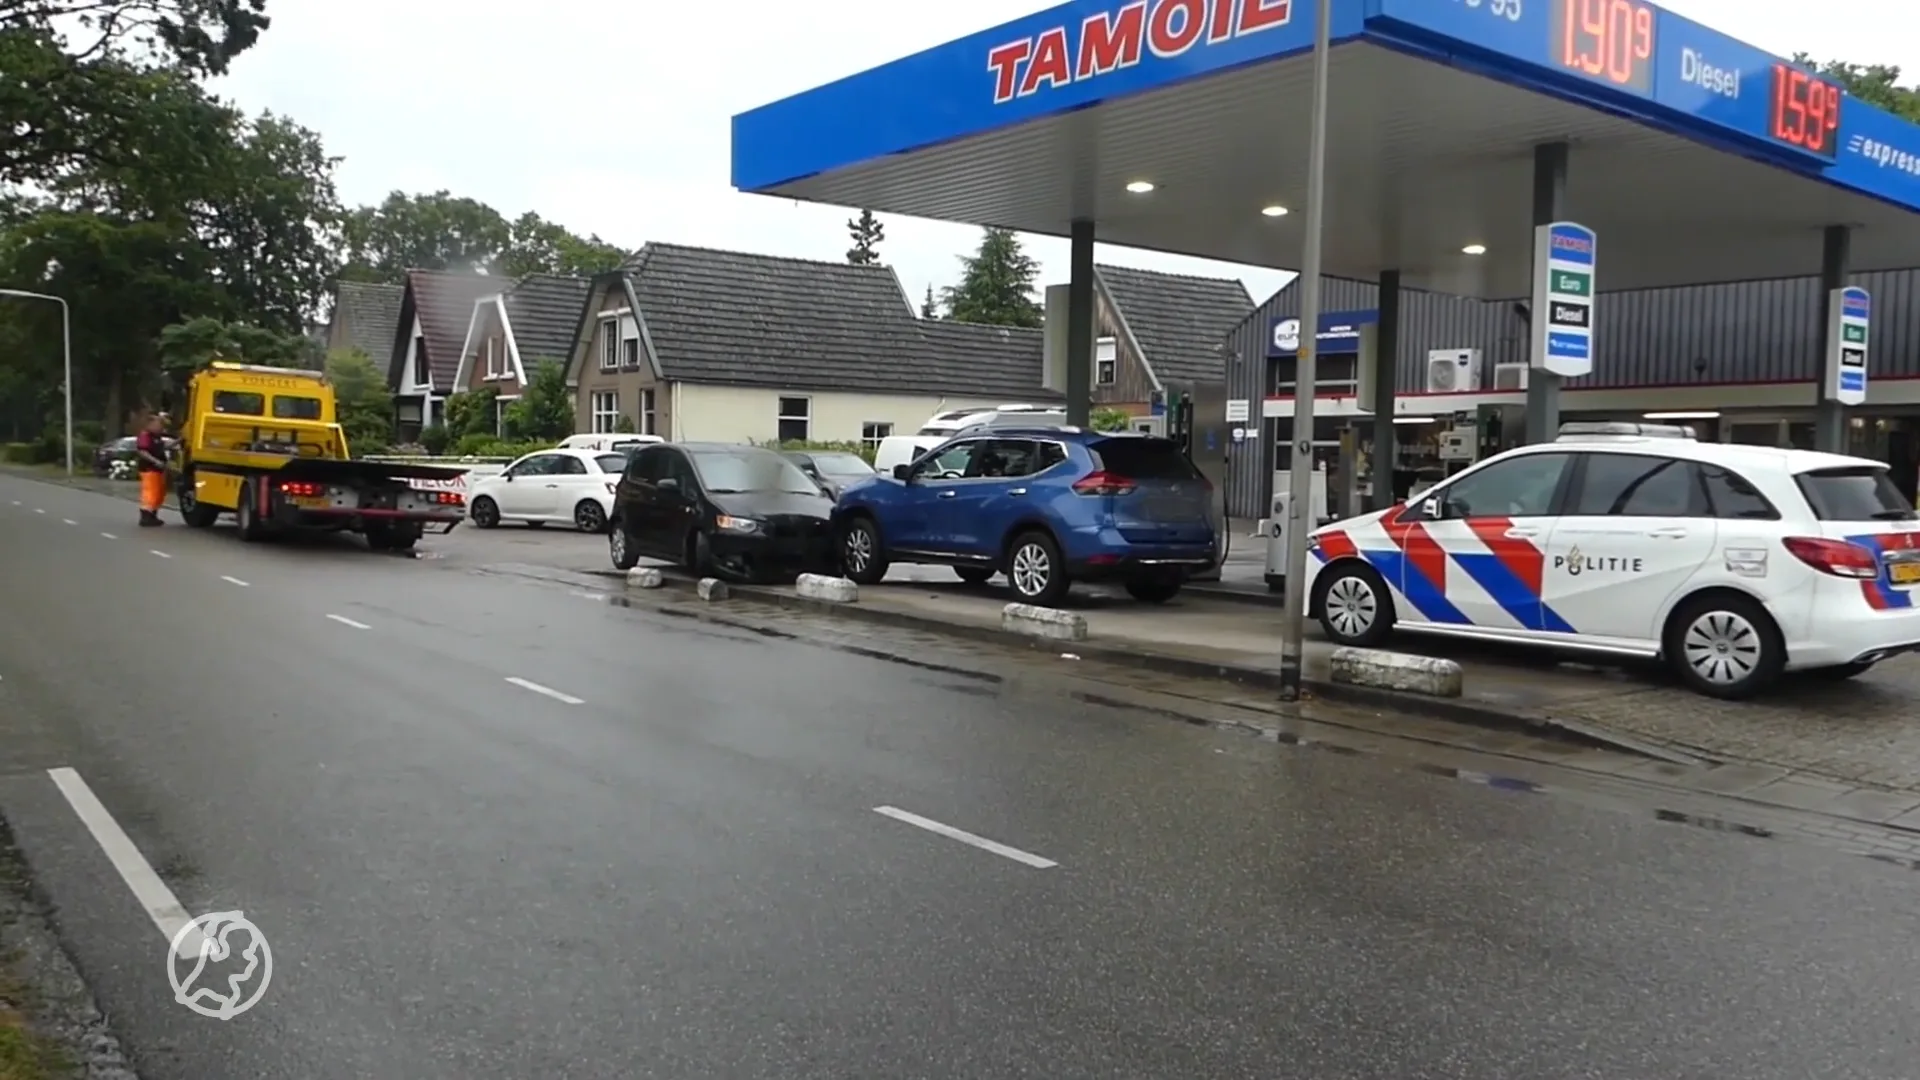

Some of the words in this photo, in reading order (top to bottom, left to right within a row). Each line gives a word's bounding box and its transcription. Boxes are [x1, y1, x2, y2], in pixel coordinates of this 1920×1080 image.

[987, 0, 1291, 104] TAMOIL
[1680, 47, 1741, 99] Diesel
[1863, 138, 1920, 176] express
[1560, 275, 1581, 291] Euro
[1555, 305, 1584, 322] Diesel
[1554, 552, 1643, 577] POLITIE
